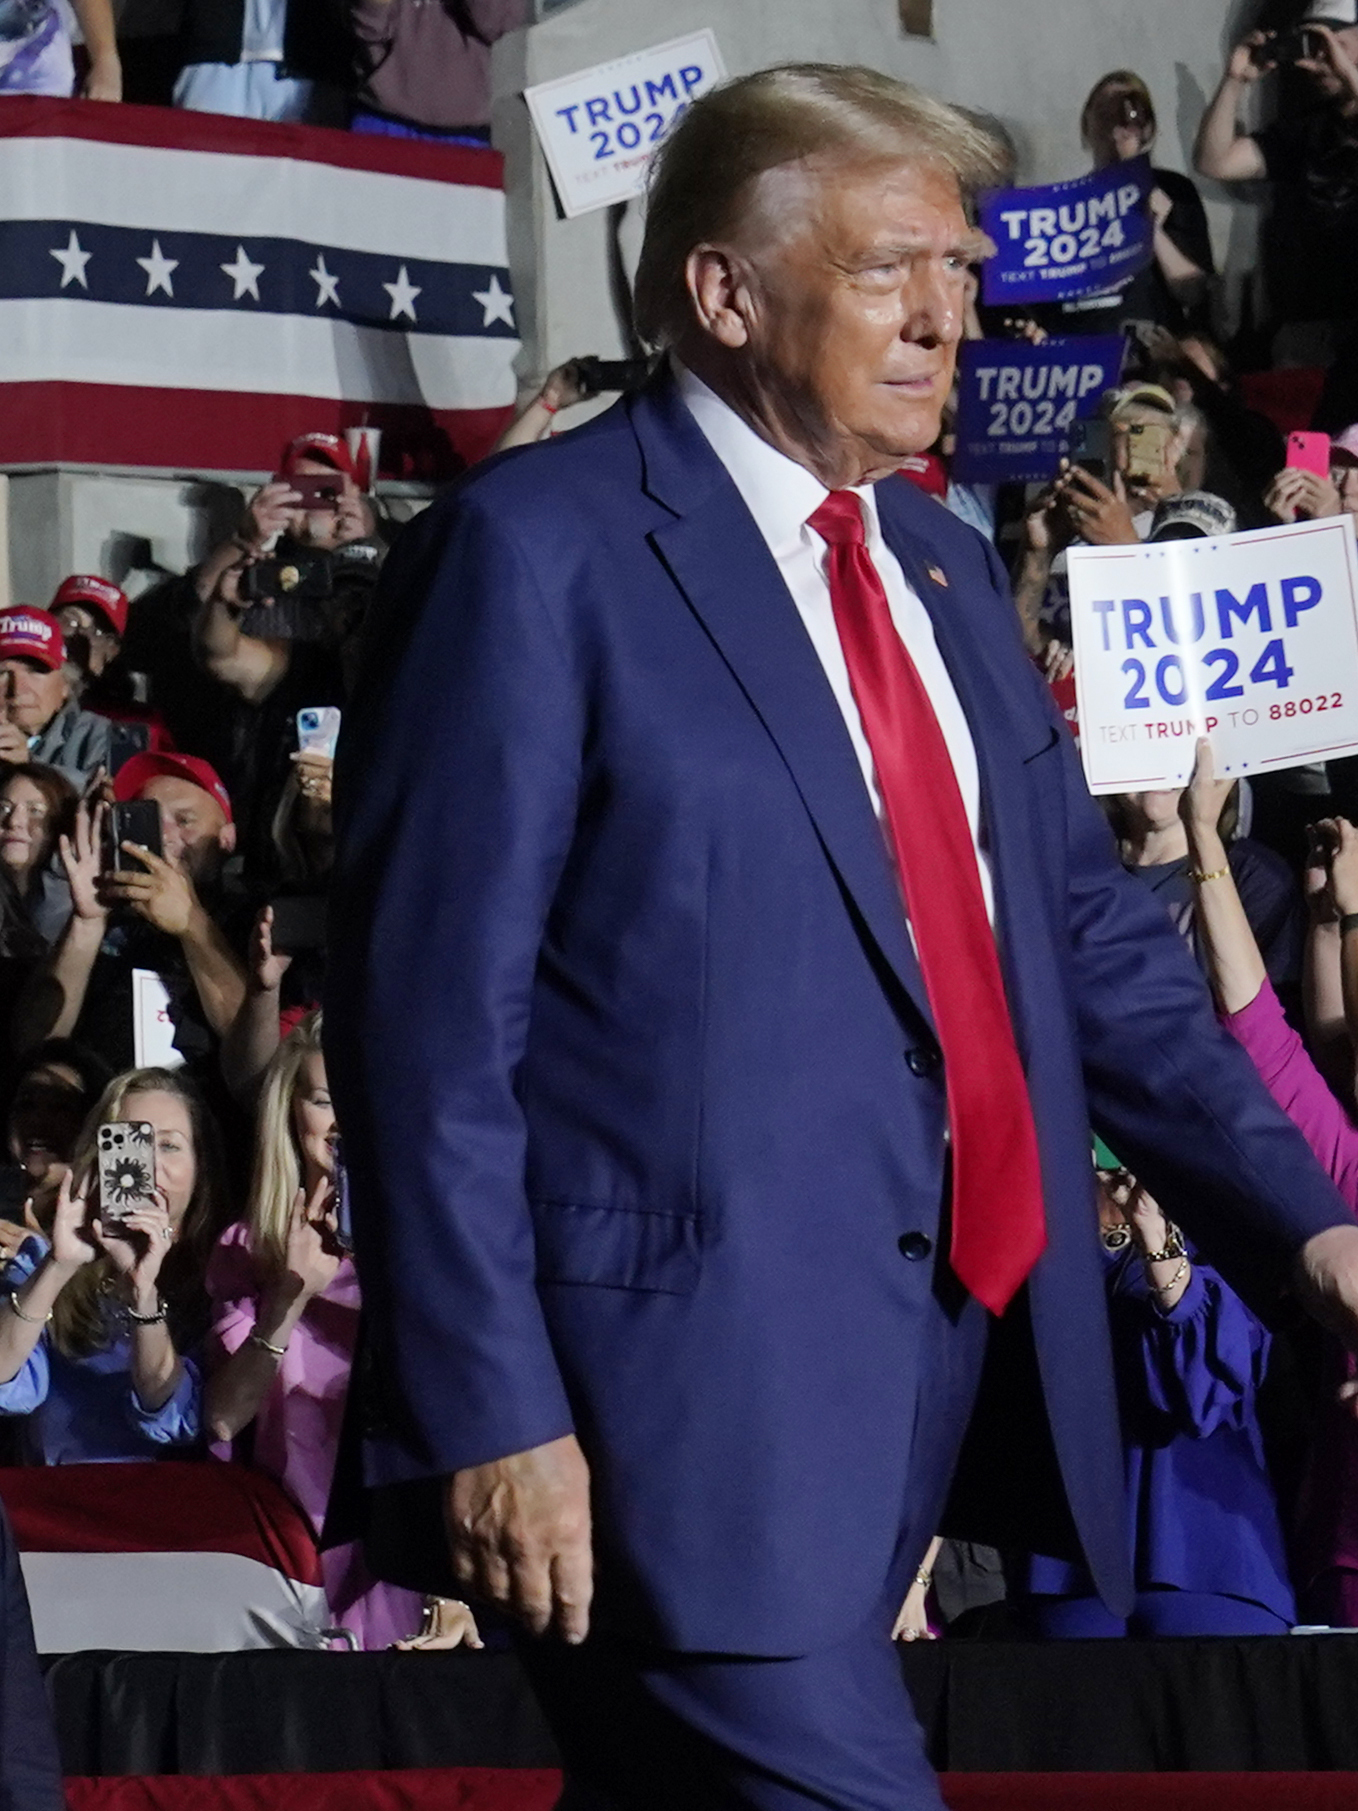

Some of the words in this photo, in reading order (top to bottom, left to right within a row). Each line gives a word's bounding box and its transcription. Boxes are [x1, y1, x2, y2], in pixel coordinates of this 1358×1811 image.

[556, 65, 703, 134] TRUMP
[1000, 184, 1141, 240] TRUMP
[1023, 219, 1125, 267] 2024
[975, 364, 1104, 400] TRUMP
[987, 399, 1078, 436] 2024
[1092, 575, 1323, 651] TRUMP
[1120, 638, 1294, 710] 2024
[1099, 723, 1138, 744] TEXT
[1227, 708, 1260, 728] TO
[1269, 692, 1344, 720] 88022
